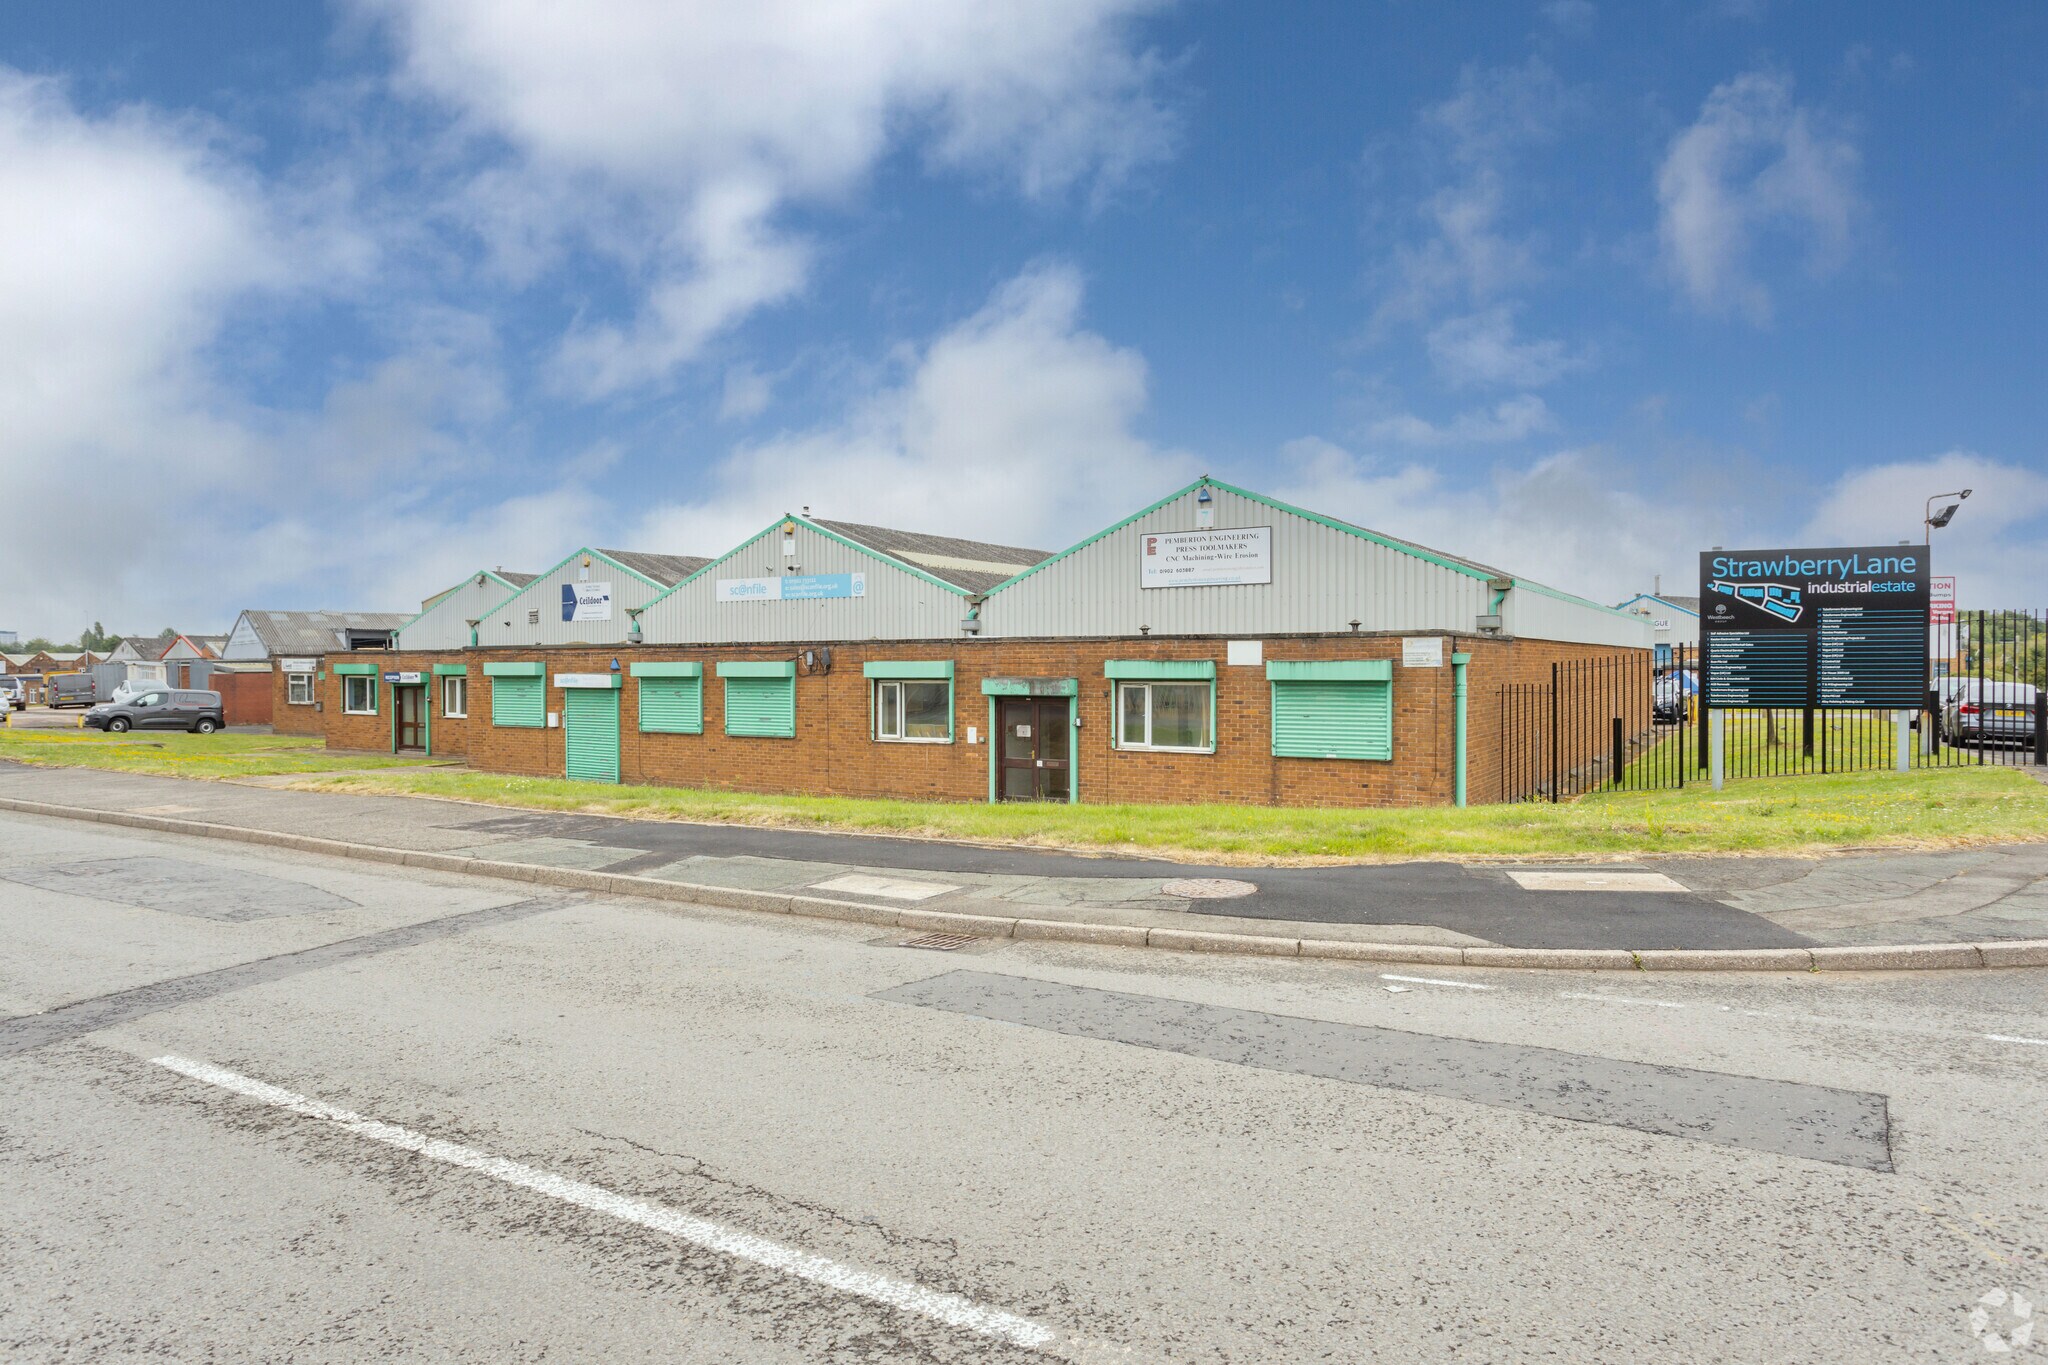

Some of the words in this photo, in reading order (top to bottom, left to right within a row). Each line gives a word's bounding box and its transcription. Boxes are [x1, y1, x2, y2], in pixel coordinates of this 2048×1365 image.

[1165, 536, 1206, 544] PEMBERTON
[1209, 533, 1259, 542] ENGINEERING
[1176, 545, 1197, 553] PRESS
[1199, 543, 1248, 552] TOOLMAKERS
